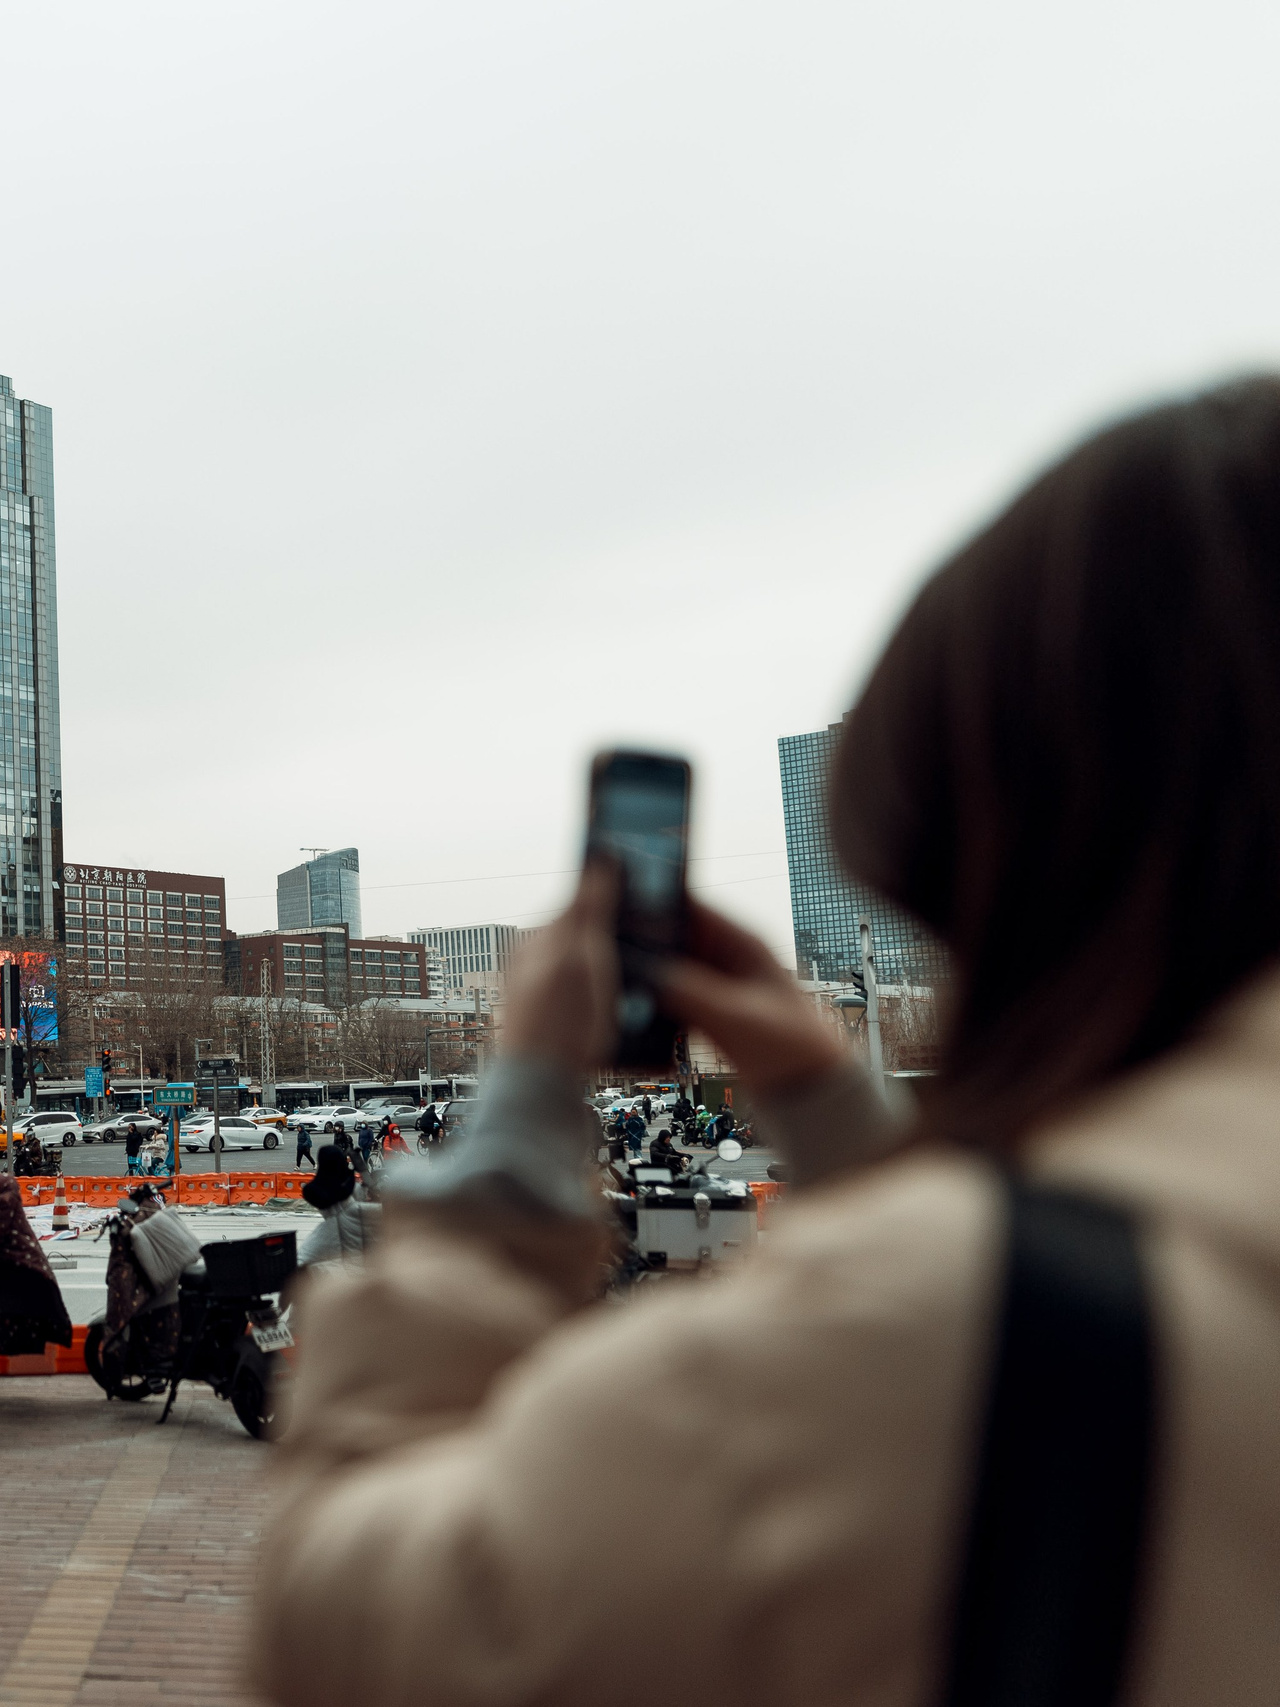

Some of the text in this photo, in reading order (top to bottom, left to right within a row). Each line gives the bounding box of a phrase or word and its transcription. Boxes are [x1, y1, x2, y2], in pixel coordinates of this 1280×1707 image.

[79, 868, 147, 885] 北京朝阳医院
